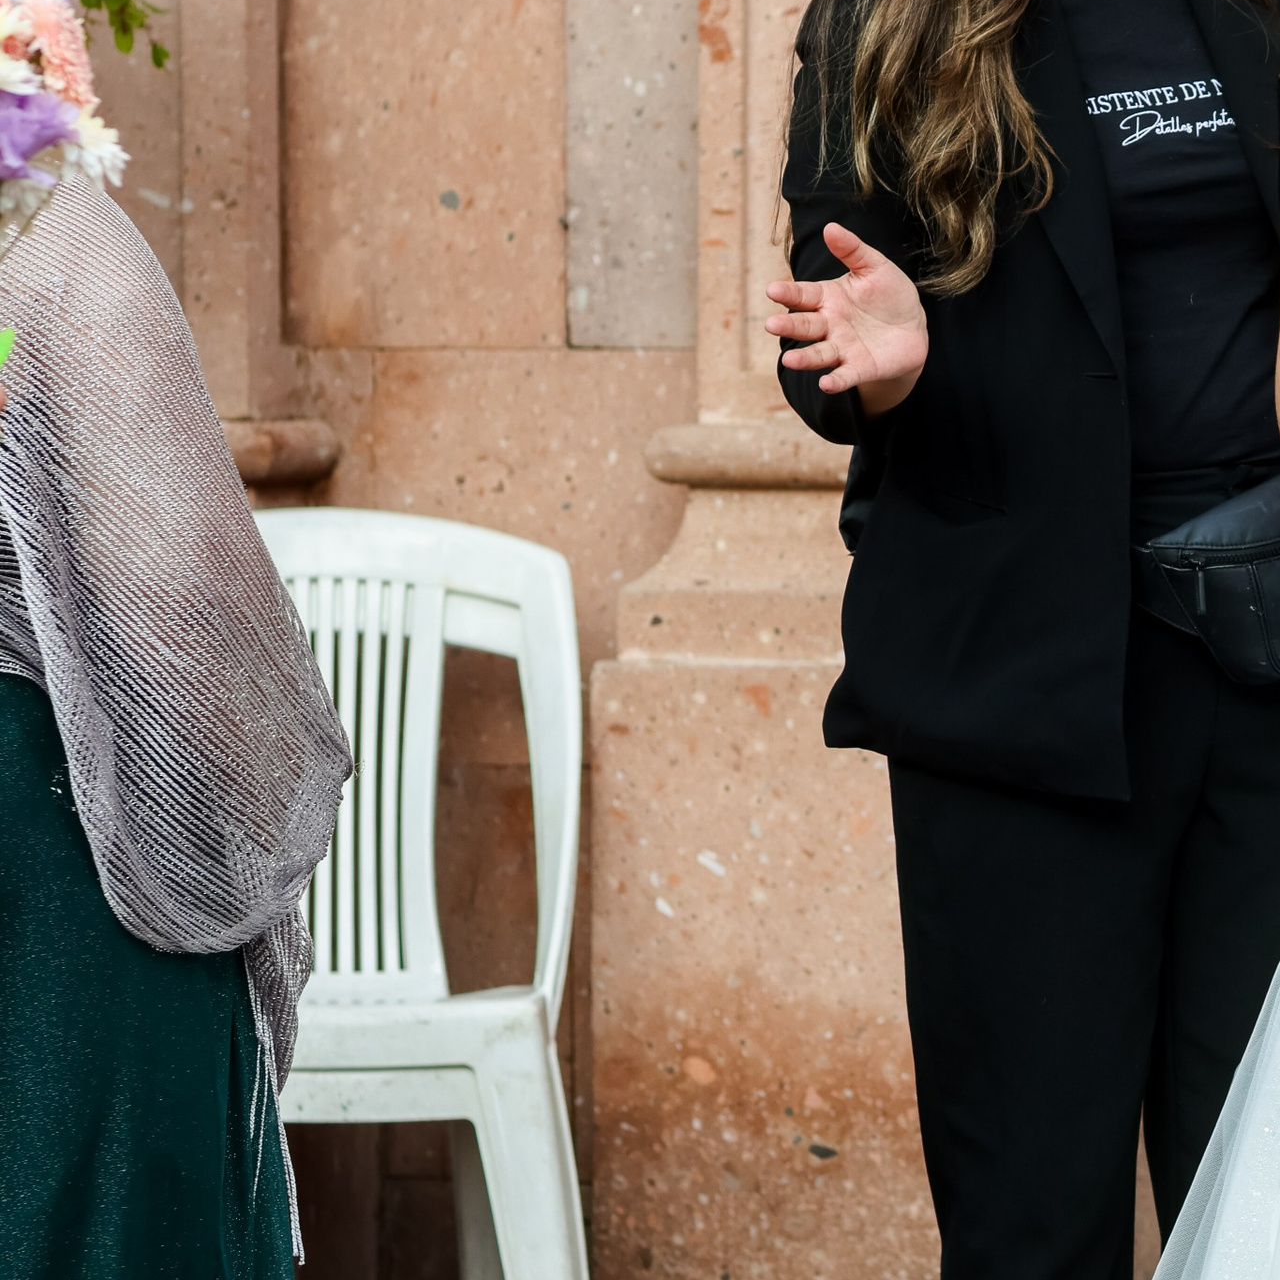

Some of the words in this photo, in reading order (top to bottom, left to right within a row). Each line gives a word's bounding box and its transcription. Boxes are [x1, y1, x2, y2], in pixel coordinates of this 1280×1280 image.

[1179, 81, 1211, 100] DE
[1119, 110, 1193, 146] Detalles
[1195, 108, 1236, 137] perfeto
